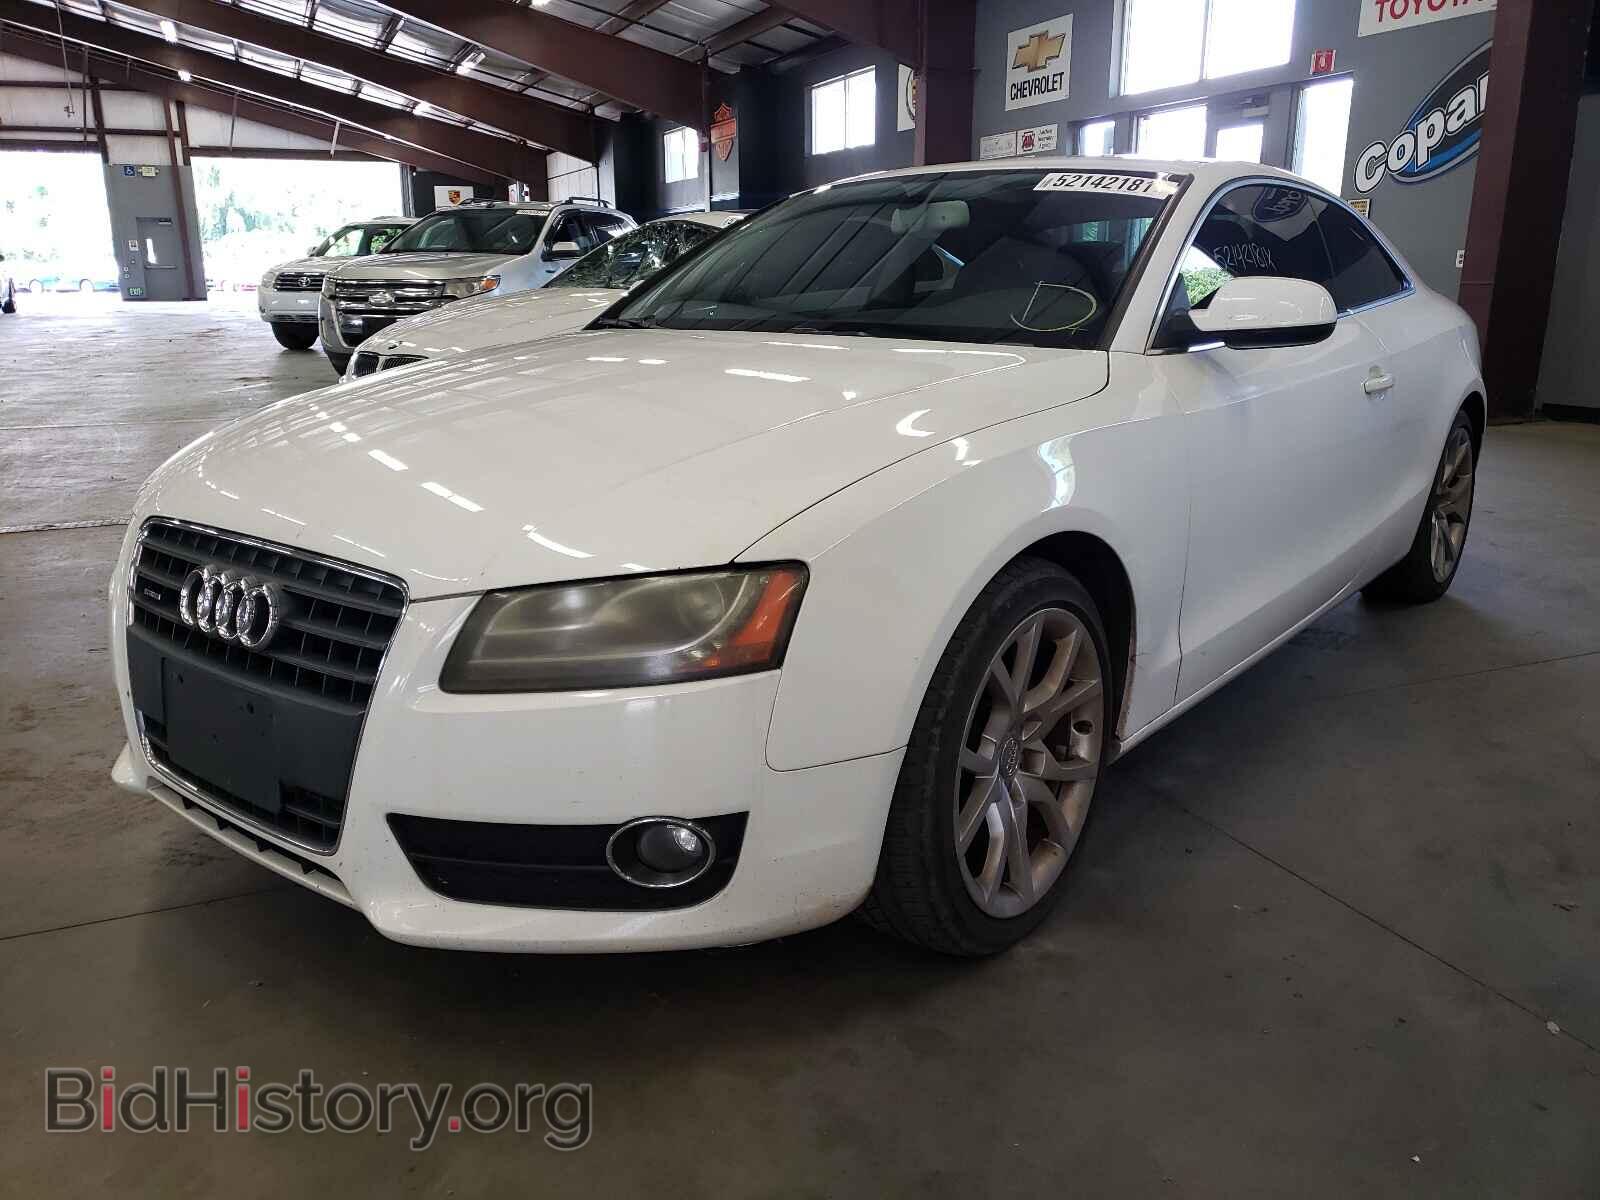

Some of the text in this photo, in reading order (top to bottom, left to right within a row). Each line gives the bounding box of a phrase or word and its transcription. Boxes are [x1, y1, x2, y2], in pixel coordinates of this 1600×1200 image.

[1375, 0, 1486, 22] TOYO
[1010, 72, 1064, 100] CHEVROLET
[1052, 174, 1154, 193] 52142181
